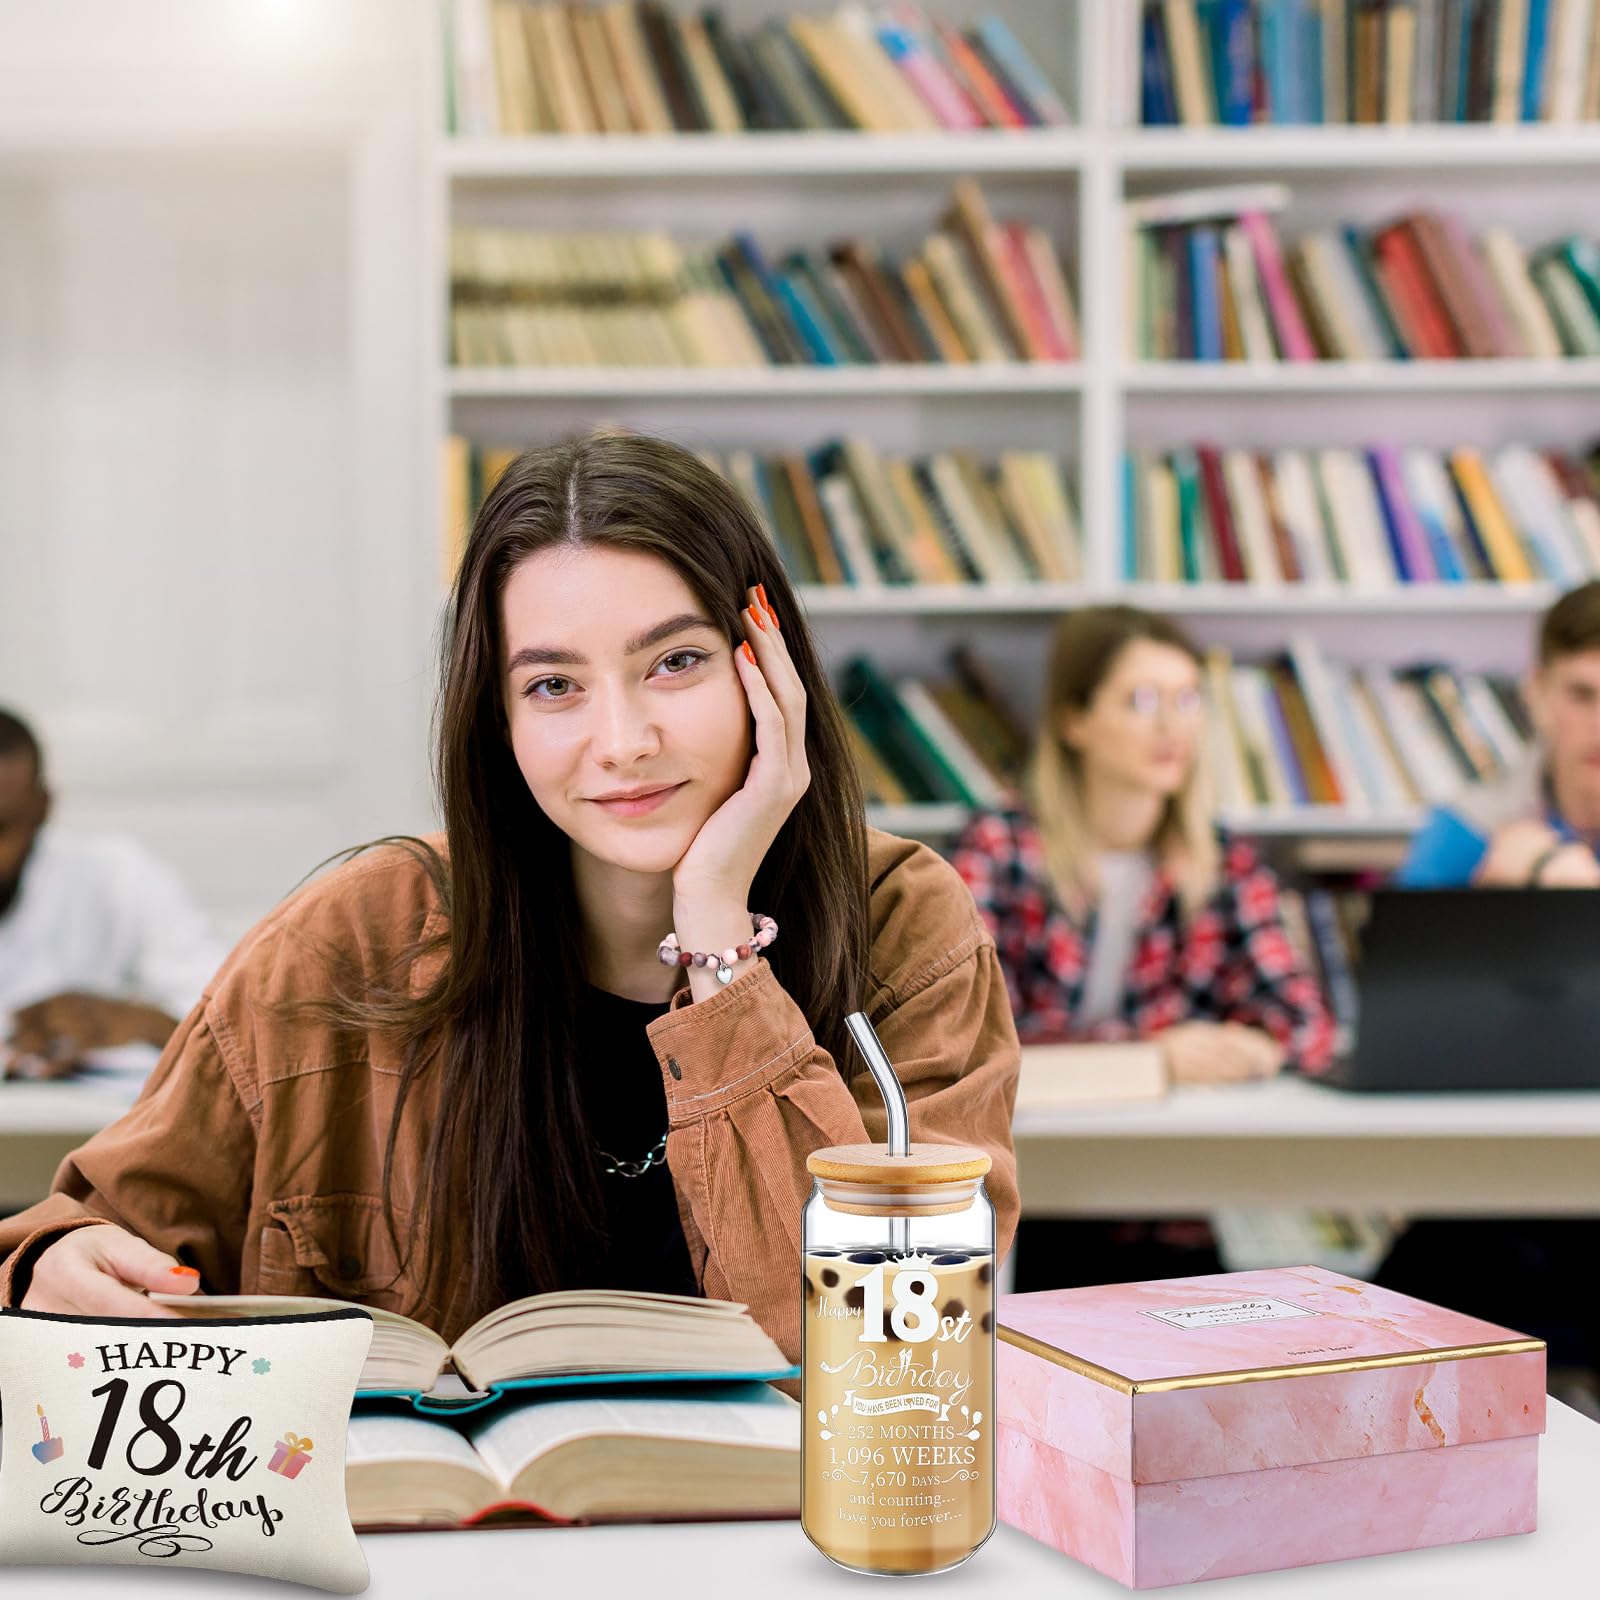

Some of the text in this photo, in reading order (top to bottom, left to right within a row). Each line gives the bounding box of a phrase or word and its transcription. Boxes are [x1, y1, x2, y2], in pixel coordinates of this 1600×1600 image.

[815, 1295, 863, 1321] Happy
[95, 1342, 247, 1375] HAPPY
[820, 1348, 974, 1405] Birthday
[87, 1377, 258, 1481] 18th
[848, 1425, 955, 1440] 252 MONTHS
[829, 1446, 976, 1468] 1,096 WEEKS
[860, 1471, 941, 1489] 7,670 DAYS
[848, 1493, 875, 1506] and
[40, 1476, 283, 1557] Birthday
[839, 1508, 867, 1525] love
[871, 1513, 896, 1529] you
